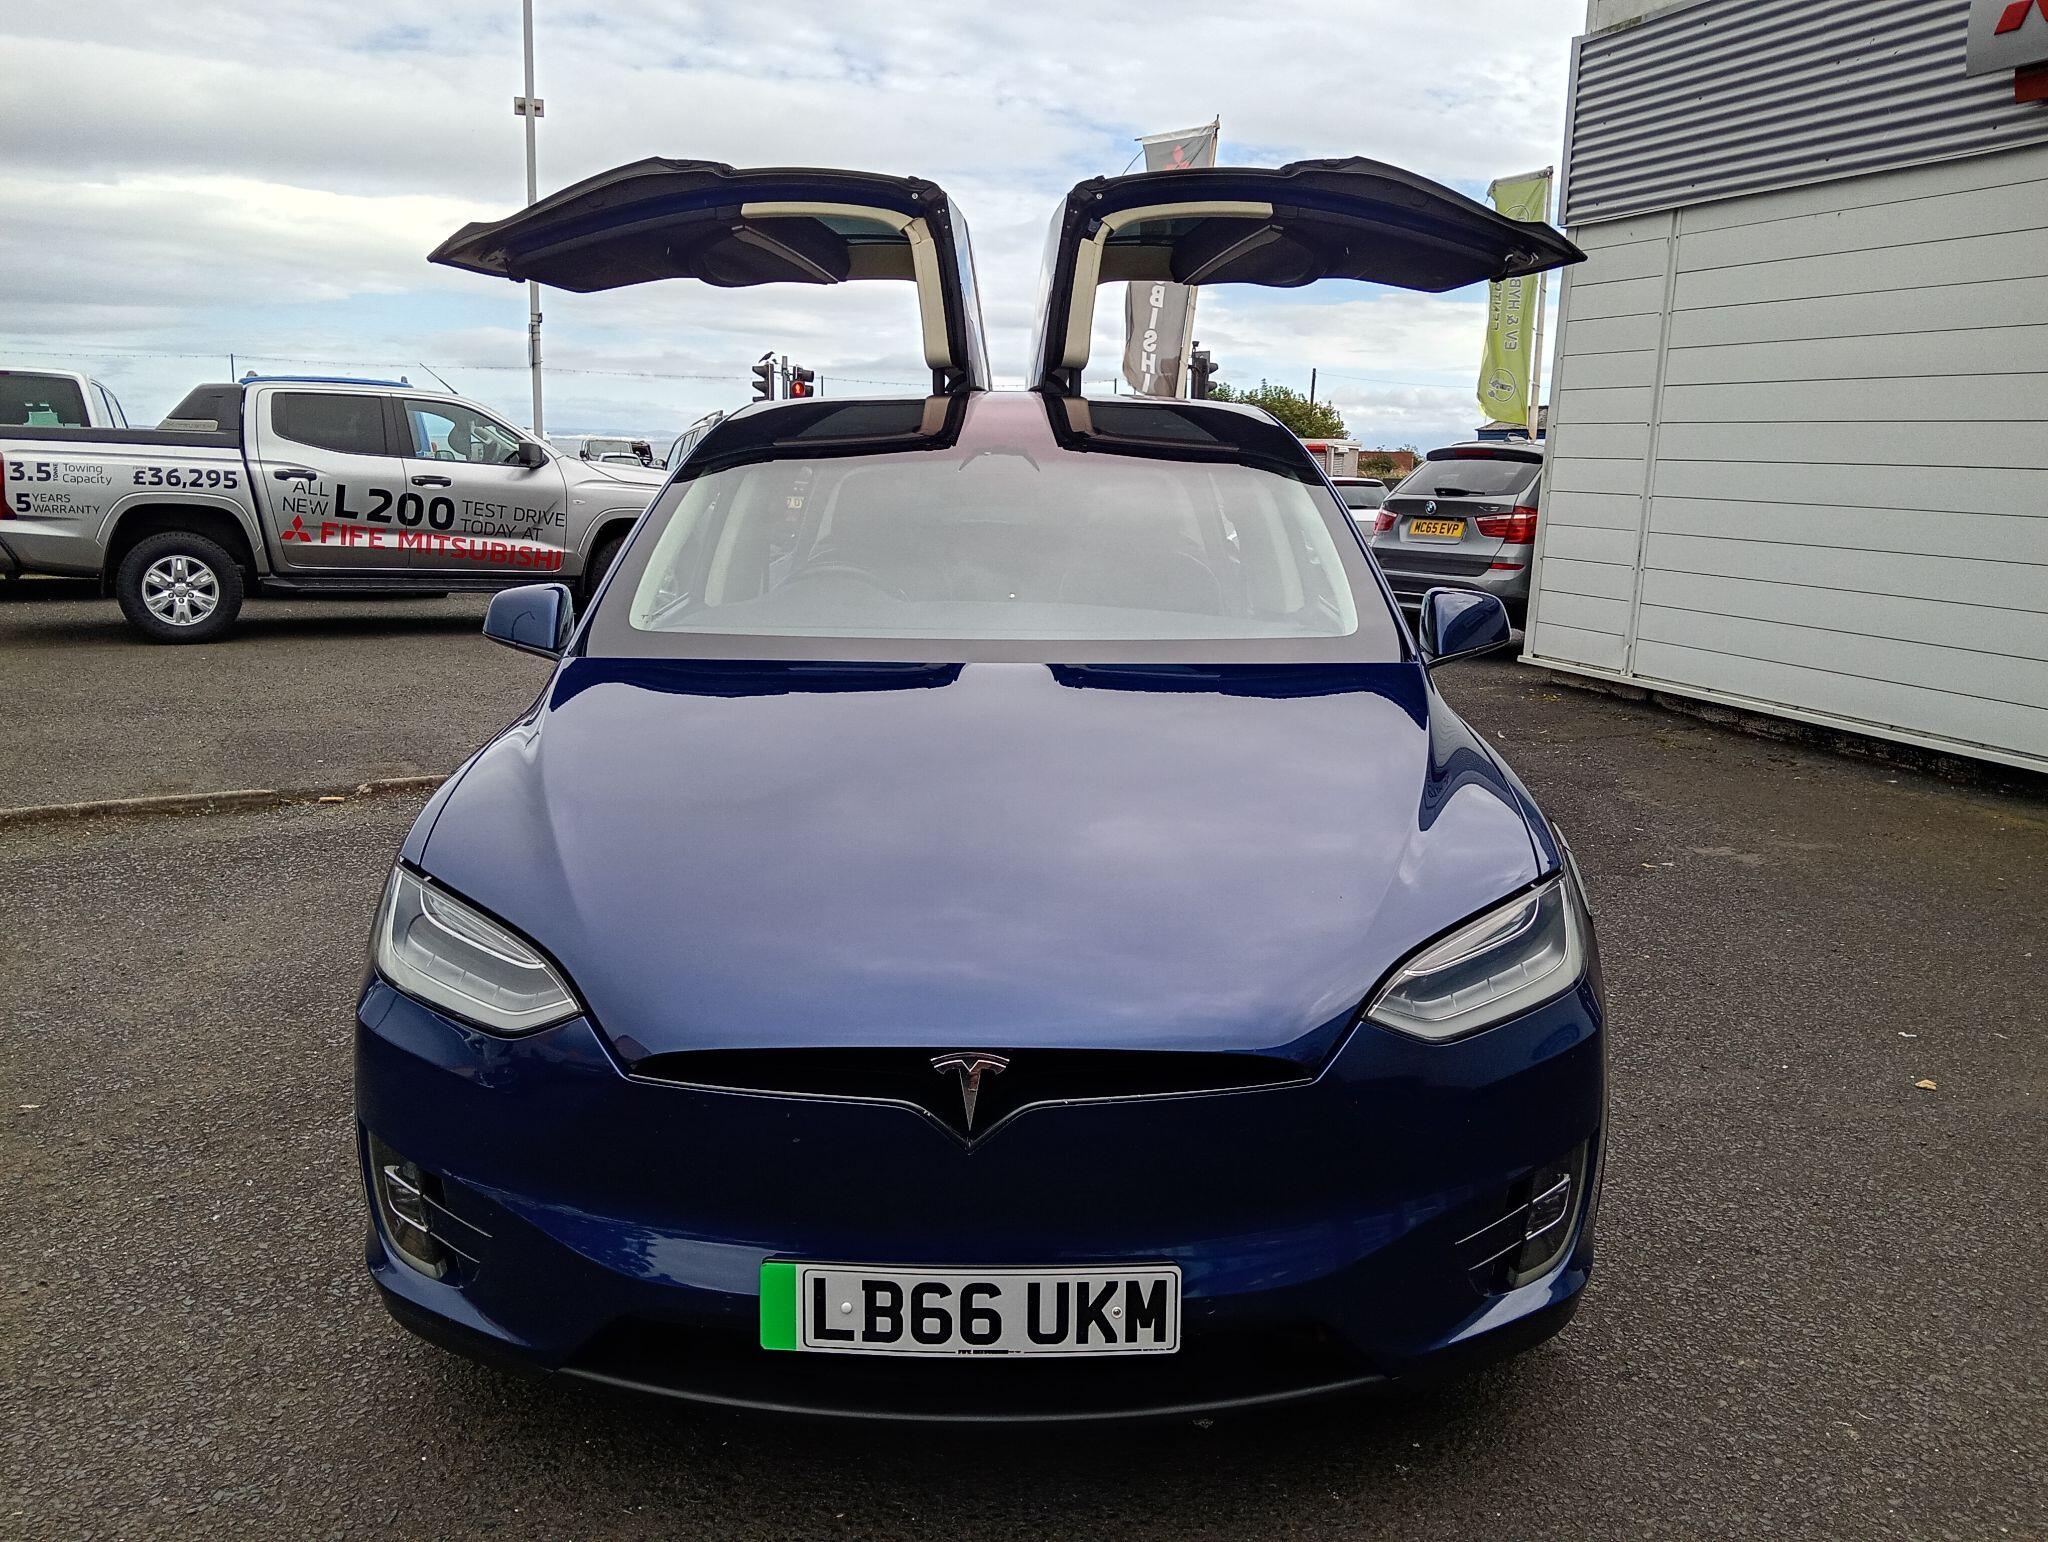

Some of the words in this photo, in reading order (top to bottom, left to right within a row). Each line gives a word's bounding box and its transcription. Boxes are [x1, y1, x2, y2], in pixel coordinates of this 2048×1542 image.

[9, 462, 51, 482] 3.5
[62, 463, 103, 475] Towing
[133, 467, 238, 489] £36,295
[62, 474, 112, 485] Capacity
[293, 480, 329, 497] ALL
[16, 493, 31, 512] 5
[32, 493, 70, 503] YEARS
[33, 504, 100, 514] WARRANTY
[283, 497, 328, 515] NEW
[335, 484, 455, 531] L200
[462, 500, 507, 519] TEST
[514, 507, 565, 527] DRIVE
[460, 518, 517, 538] TODAY
[521, 527, 543, 541] AT
[1414, 522, 1437, 534] MC65
[1440, 523, 1459, 534] EVP
[320, 521, 387, 550] FIFE
[397, 530, 562, 570] MITSUBISHI
[813, 1277, 1002, 1346] LB66
[1027, 1279, 1168, 1345] UKM
